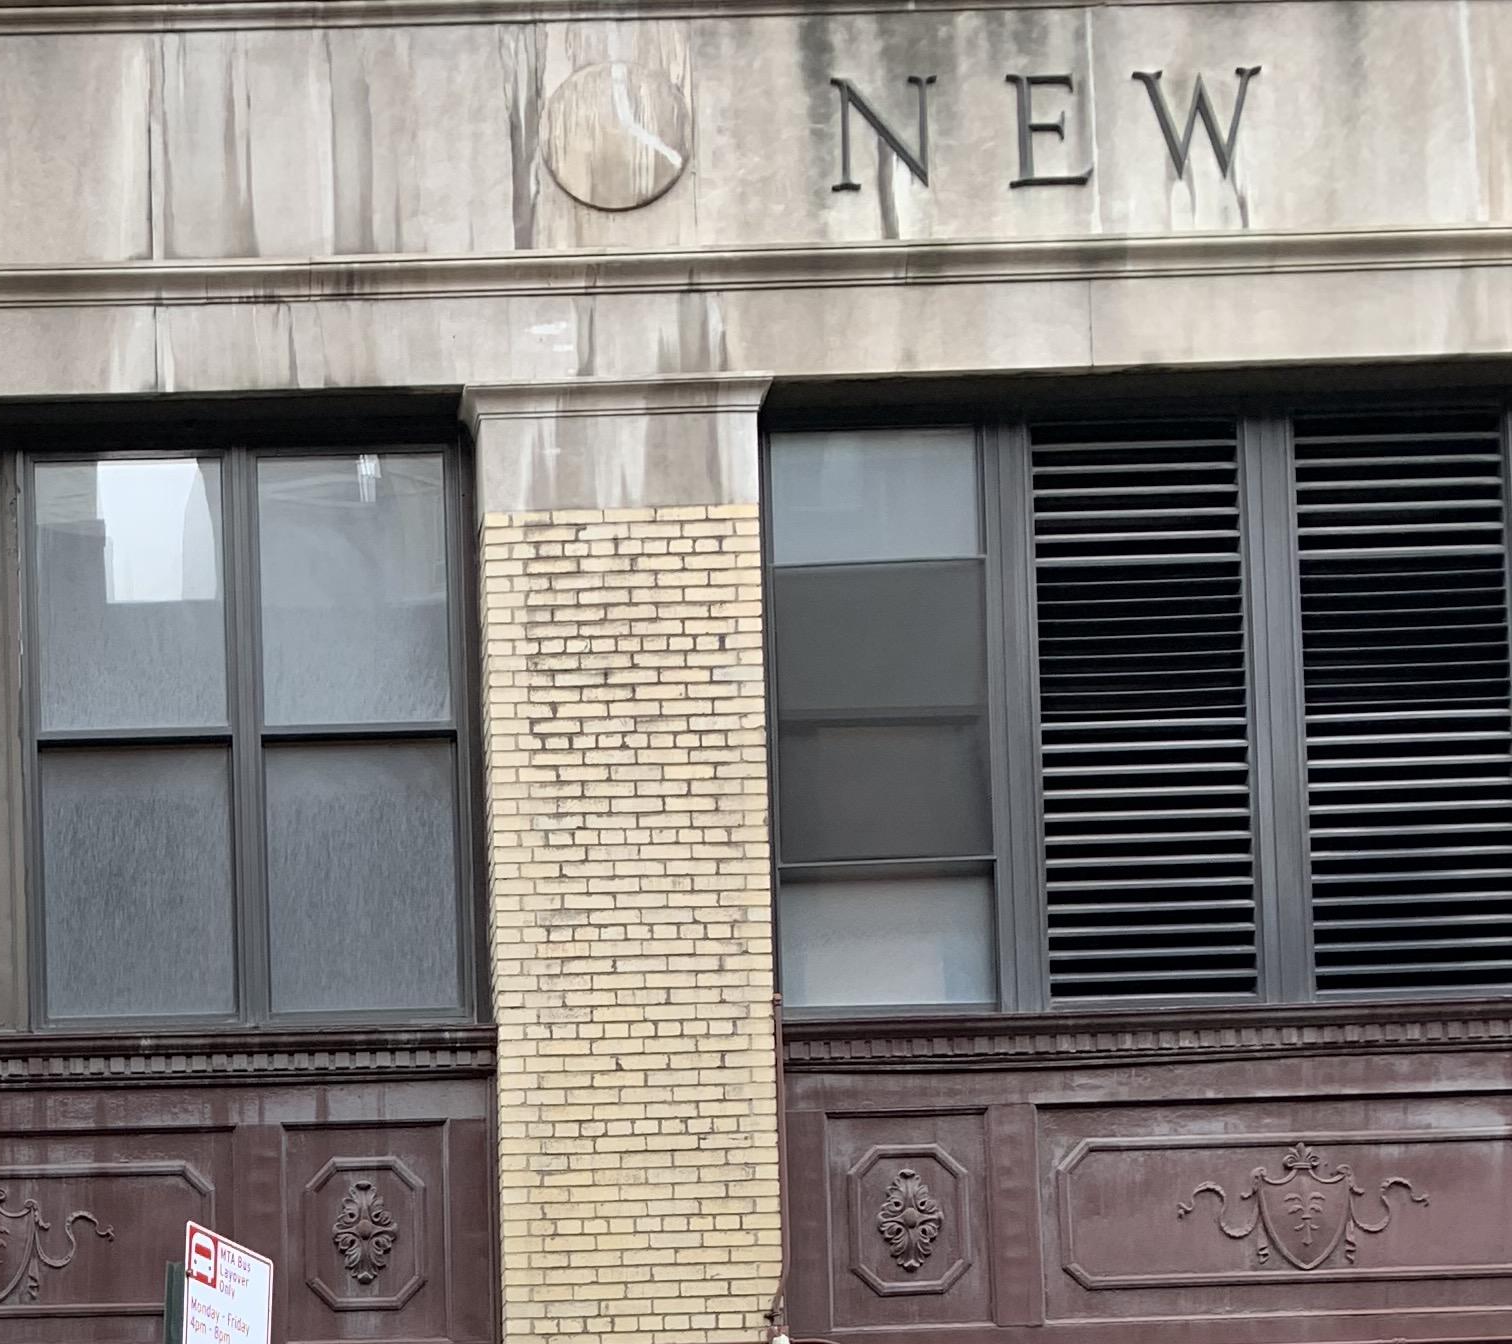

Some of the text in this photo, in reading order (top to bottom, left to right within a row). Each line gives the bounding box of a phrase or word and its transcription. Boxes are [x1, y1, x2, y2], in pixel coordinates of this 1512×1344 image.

[830, 65, 1262, 193] NEW
[220, 1247, 251, 1272] MTA Bus
[219, 1266, 249, 1288] Layover
[219, 1280, 236, 1299] Only
[190, 1316, 207, 1334] 4pm
[191, 1296, 220, 1324] Monday
[227, 1312, 250, 1336] Friday
